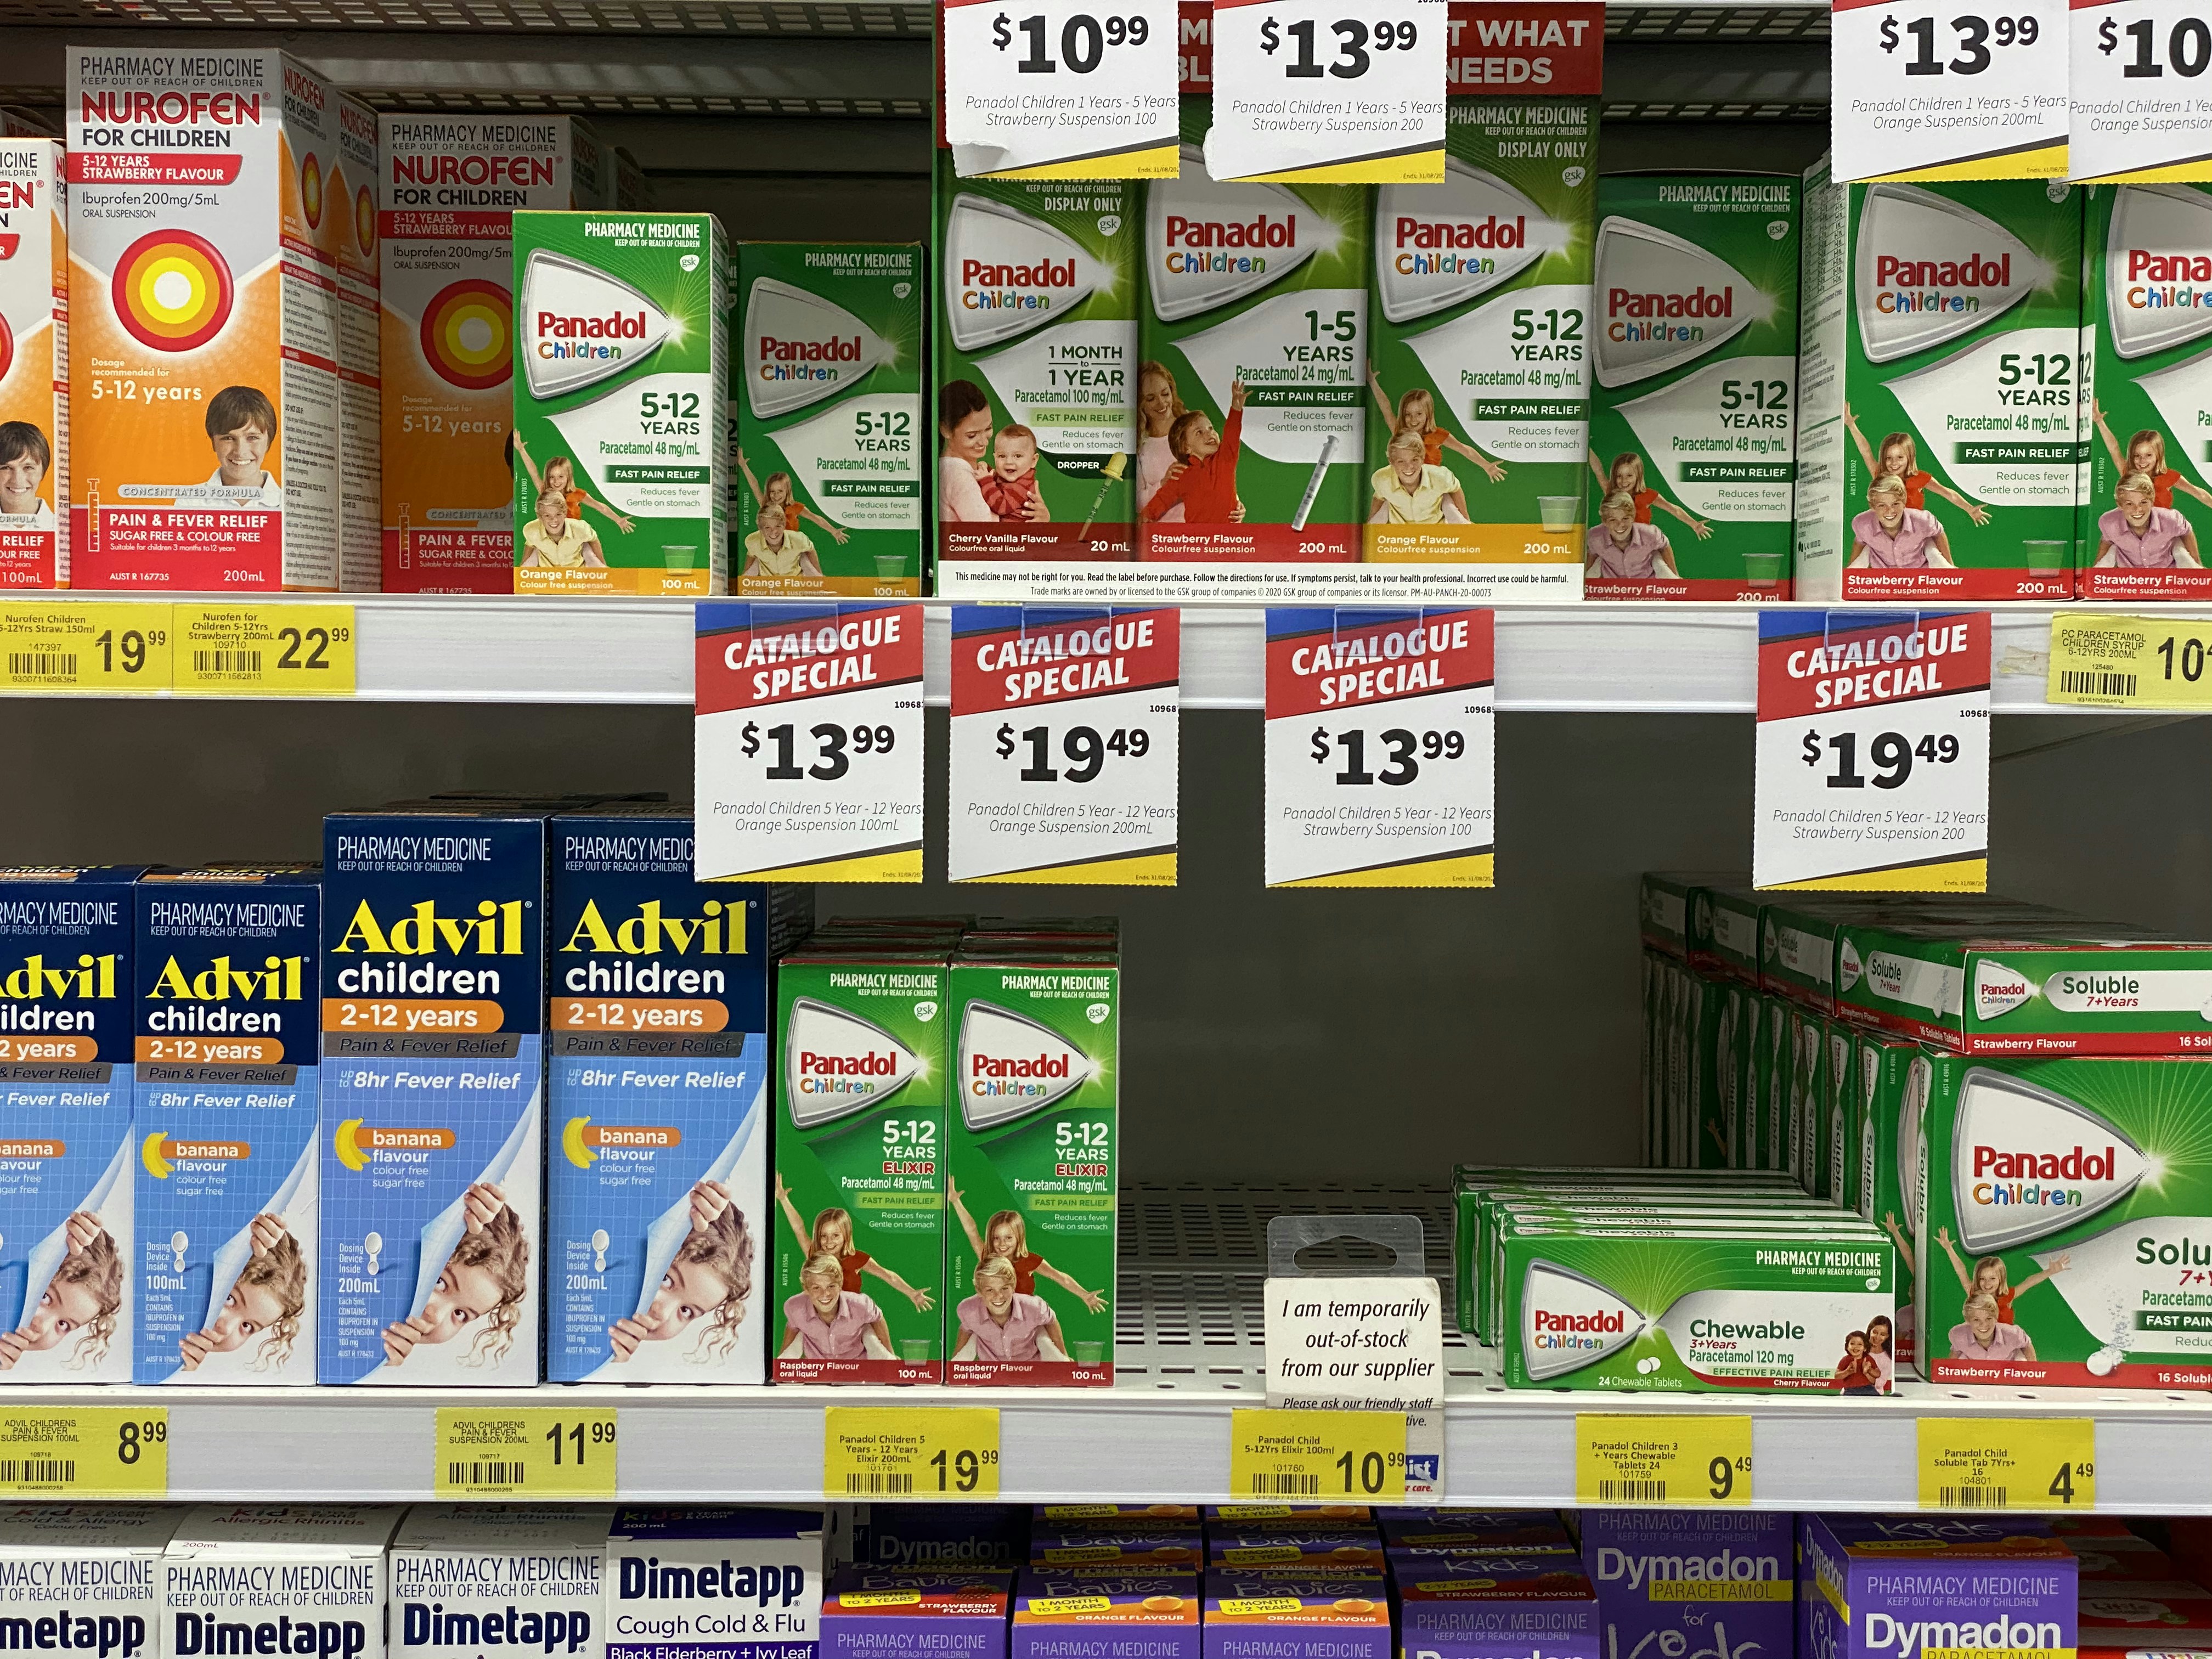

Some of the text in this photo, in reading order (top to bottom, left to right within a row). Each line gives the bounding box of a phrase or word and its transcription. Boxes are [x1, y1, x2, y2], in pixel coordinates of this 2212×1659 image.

[1476, 20, 1589, 46] WHAT
[81, 58, 264, 78] PHARMACY MEDICINE
[82, 91, 259, 125] NUROFEN
[966, 95, 1074, 108] Panadol Children
[986, 112, 1156, 128] Strawberry Suspension 100
[83, 129, 230, 147] FOR CHILDREN
[1499, 142, 1587, 157] DISPLAY ONLY
[83, 156, 149, 167] 5-12 YEARS
[83, 166, 223, 180] STRAWBERRY FLAVOUR
[83, 191, 219, 208] Ibuprofen 200mg/5mL
[83, 209, 155, 218] ORAL SUSPENSION
[539, 311, 645, 338] Panadol
[538, 342, 621, 359] Children
[1049, 346, 1122, 359] 1 MONTH
[1049, 370, 1124, 386] 1 YEAR
[641, 393, 699, 417] 5-12
[641, 421, 699, 435] YEARS
[110, 514, 267, 527] PAIN & FEVER RELIEF
[949, 535, 982, 545] Cherry
[985, 535, 1018, 543] Vanilla
[1091, 541, 1130, 551] 20 mL
[224, 570, 264, 581] 200mL
[520, 570, 607, 581] Orange Flavour
[1042, 573, 1057, 582] right
[662, 580, 681, 588] 100
[203, 613, 258, 621] Nurofen for
[192, 622, 231, 630] Children
[188, 631, 240, 641] Strawberry
[723, 614, 901, 670] CATALOGUE
[2077, 630, 2146, 641] PARACETAMOL
[213, 641, 247, 649] 109710
[752, 661, 877, 699] SPECIAL
[736, 819, 899, 834] Orange Suspension 100mL
[337, 836, 491, 861] PHARMACY MEDICINE
[331, 899, 526, 955] Advil
[338, 961, 499, 994] children
[2063, 976, 2138, 994] Soluble
[340, 1005, 477, 1031] 2-12 years
[340, 1038, 507, 1053] Pain & Fever Relief
[1974, 1039, 2076, 1049] Strawberry Flavour
[373, 1131, 441, 1146] banana
[373, 1149, 428, 1163] flavour
[373, 1163, 428, 1175] colour free
[883, 1161, 935, 1175] ELIXIR
[373, 1178, 425, 1188] sugar free
[340, 1243, 363, 1254] Dosing
[340, 1252, 364, 1263] Device
[340, 1262, 362, 1273] Inside
[339, 1278, 380, 1293] 200mL
[1283, 1299, 1430, 1321] I am temporarily
[1690, 1319, 1804, 1339] Chewable
[1306, 1329, 1408, 1347] out-of-stock
[780, 1362, 824, 1373] Raspberry
[796, 1369, 817, 1378] liquid
[1282, 1358, 1435, 1381] from our supplier
[1713, 1368, 1767, 1376] EFFECTIVE
[1770, 1369, 1793, 1377] PAIN
[1599, 1376, 1681, 1387] 24 Chewable Tablets
[1283, 1398, 1433, 1411] Please ask our friendly staff
[1598, 1548, 1780, 1591] Dymadon
[620, 1557, 804, 1607] Dimetapp
[1655, 1583, 1773, 1599] PARACETAMOL
[617, 1614, 804, 1638] Cough Cold & Flu
